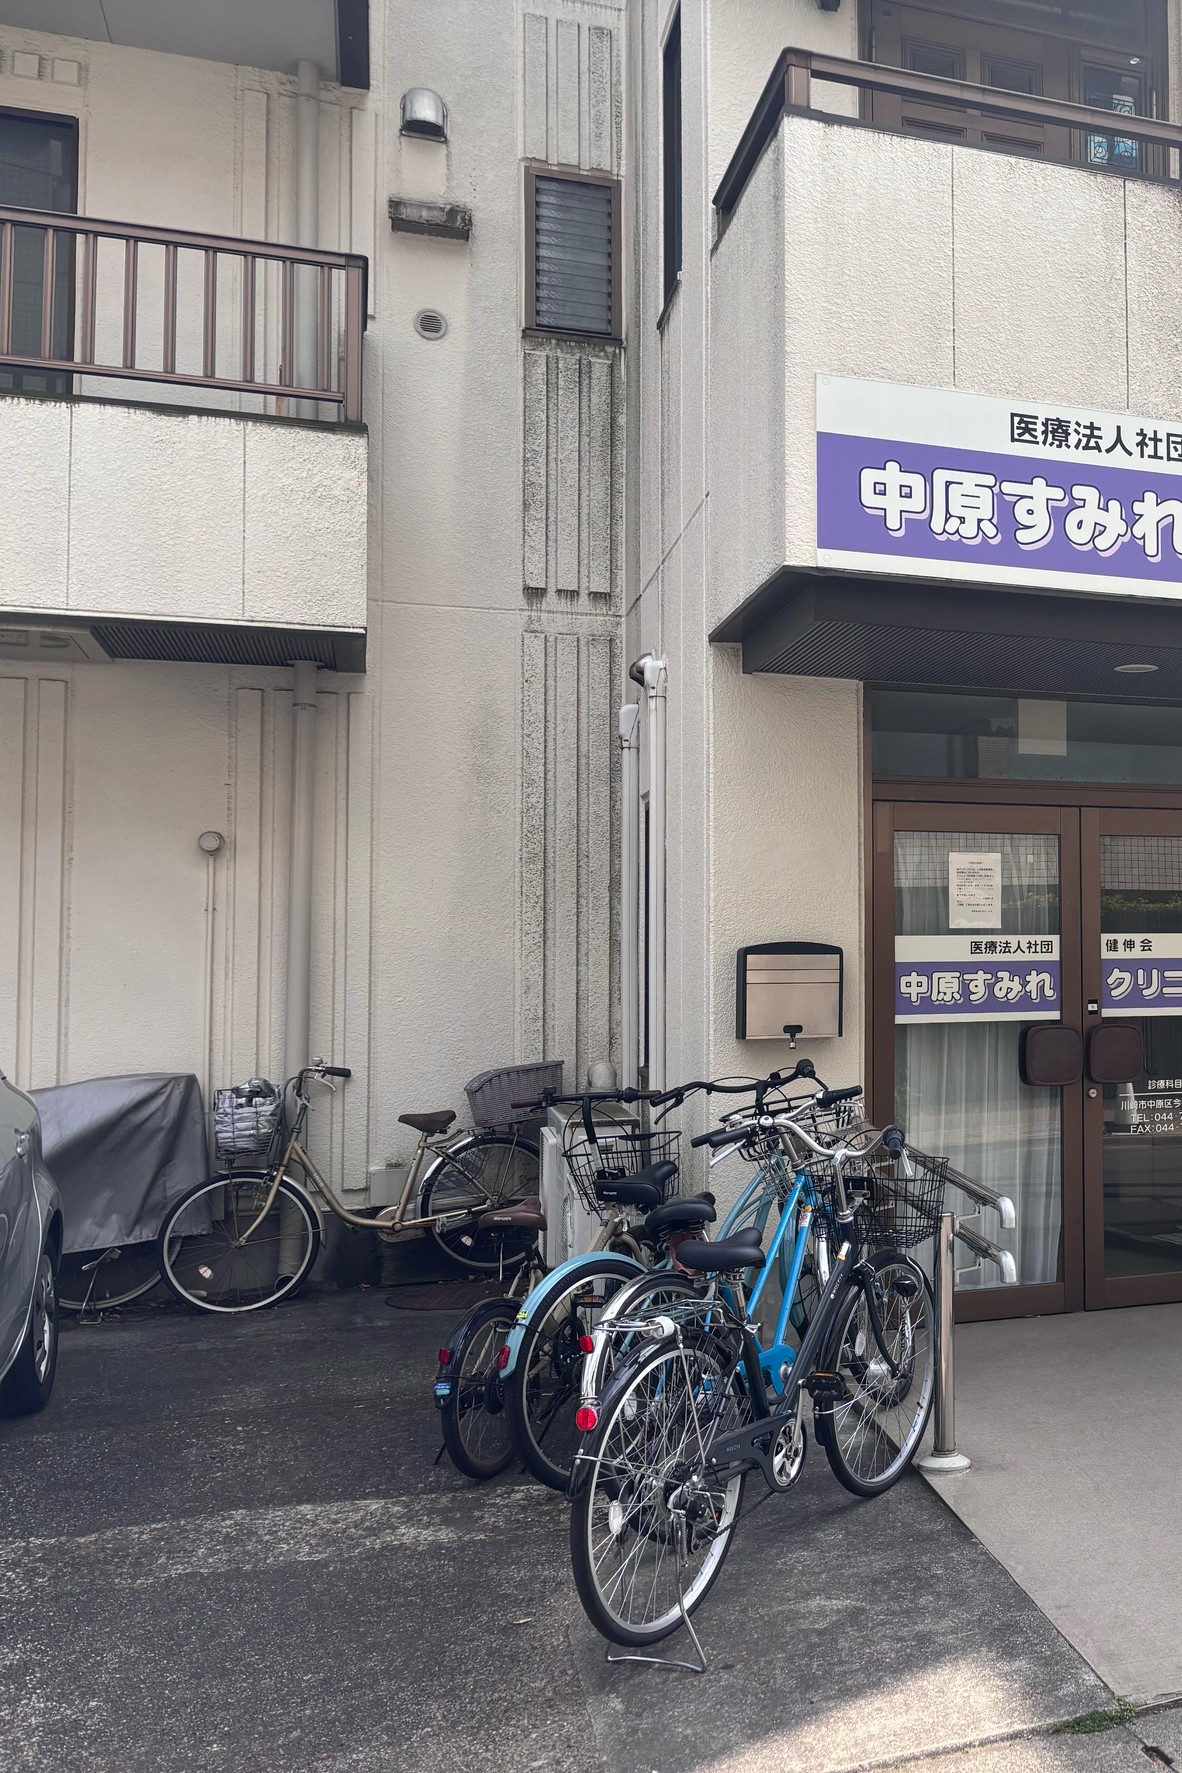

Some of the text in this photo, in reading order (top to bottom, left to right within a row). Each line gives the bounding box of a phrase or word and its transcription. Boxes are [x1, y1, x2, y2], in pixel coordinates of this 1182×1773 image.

[970, 938, 1153, 955] 医療法人社団 健伸会
[899, 968, 1057, 1006] 中原すみれ
[1147, 1079, 1182, 1090] 診療科目
